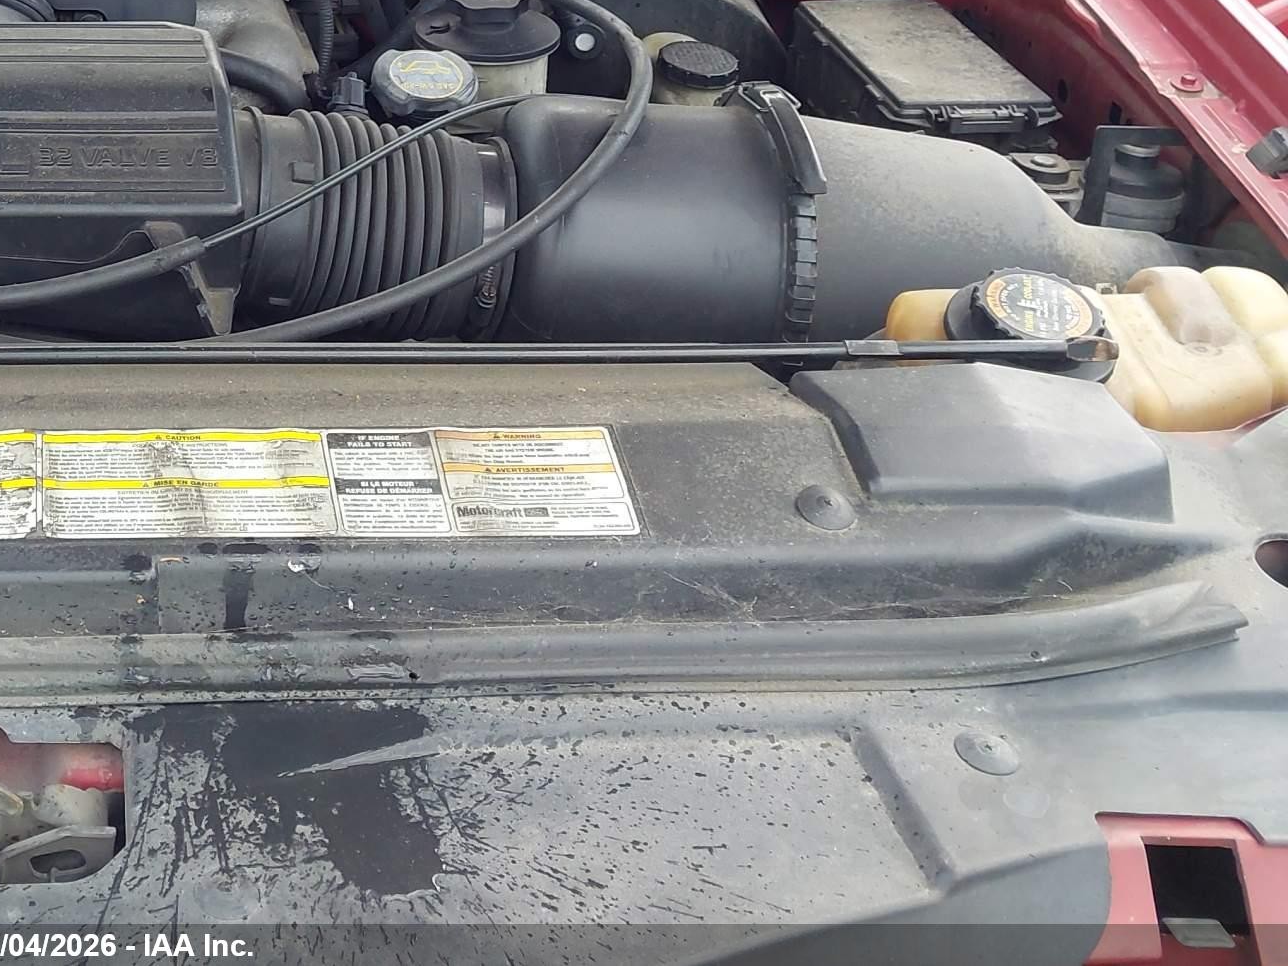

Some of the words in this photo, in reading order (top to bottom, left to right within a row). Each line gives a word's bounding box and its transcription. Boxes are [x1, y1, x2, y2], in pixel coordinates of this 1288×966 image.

[39, 147, 72, 166] 32
[82, 146, 171, 166] VALVE
[183, 146, 218, 166] V8
[456, 506, 524, 519] Motorcraft
